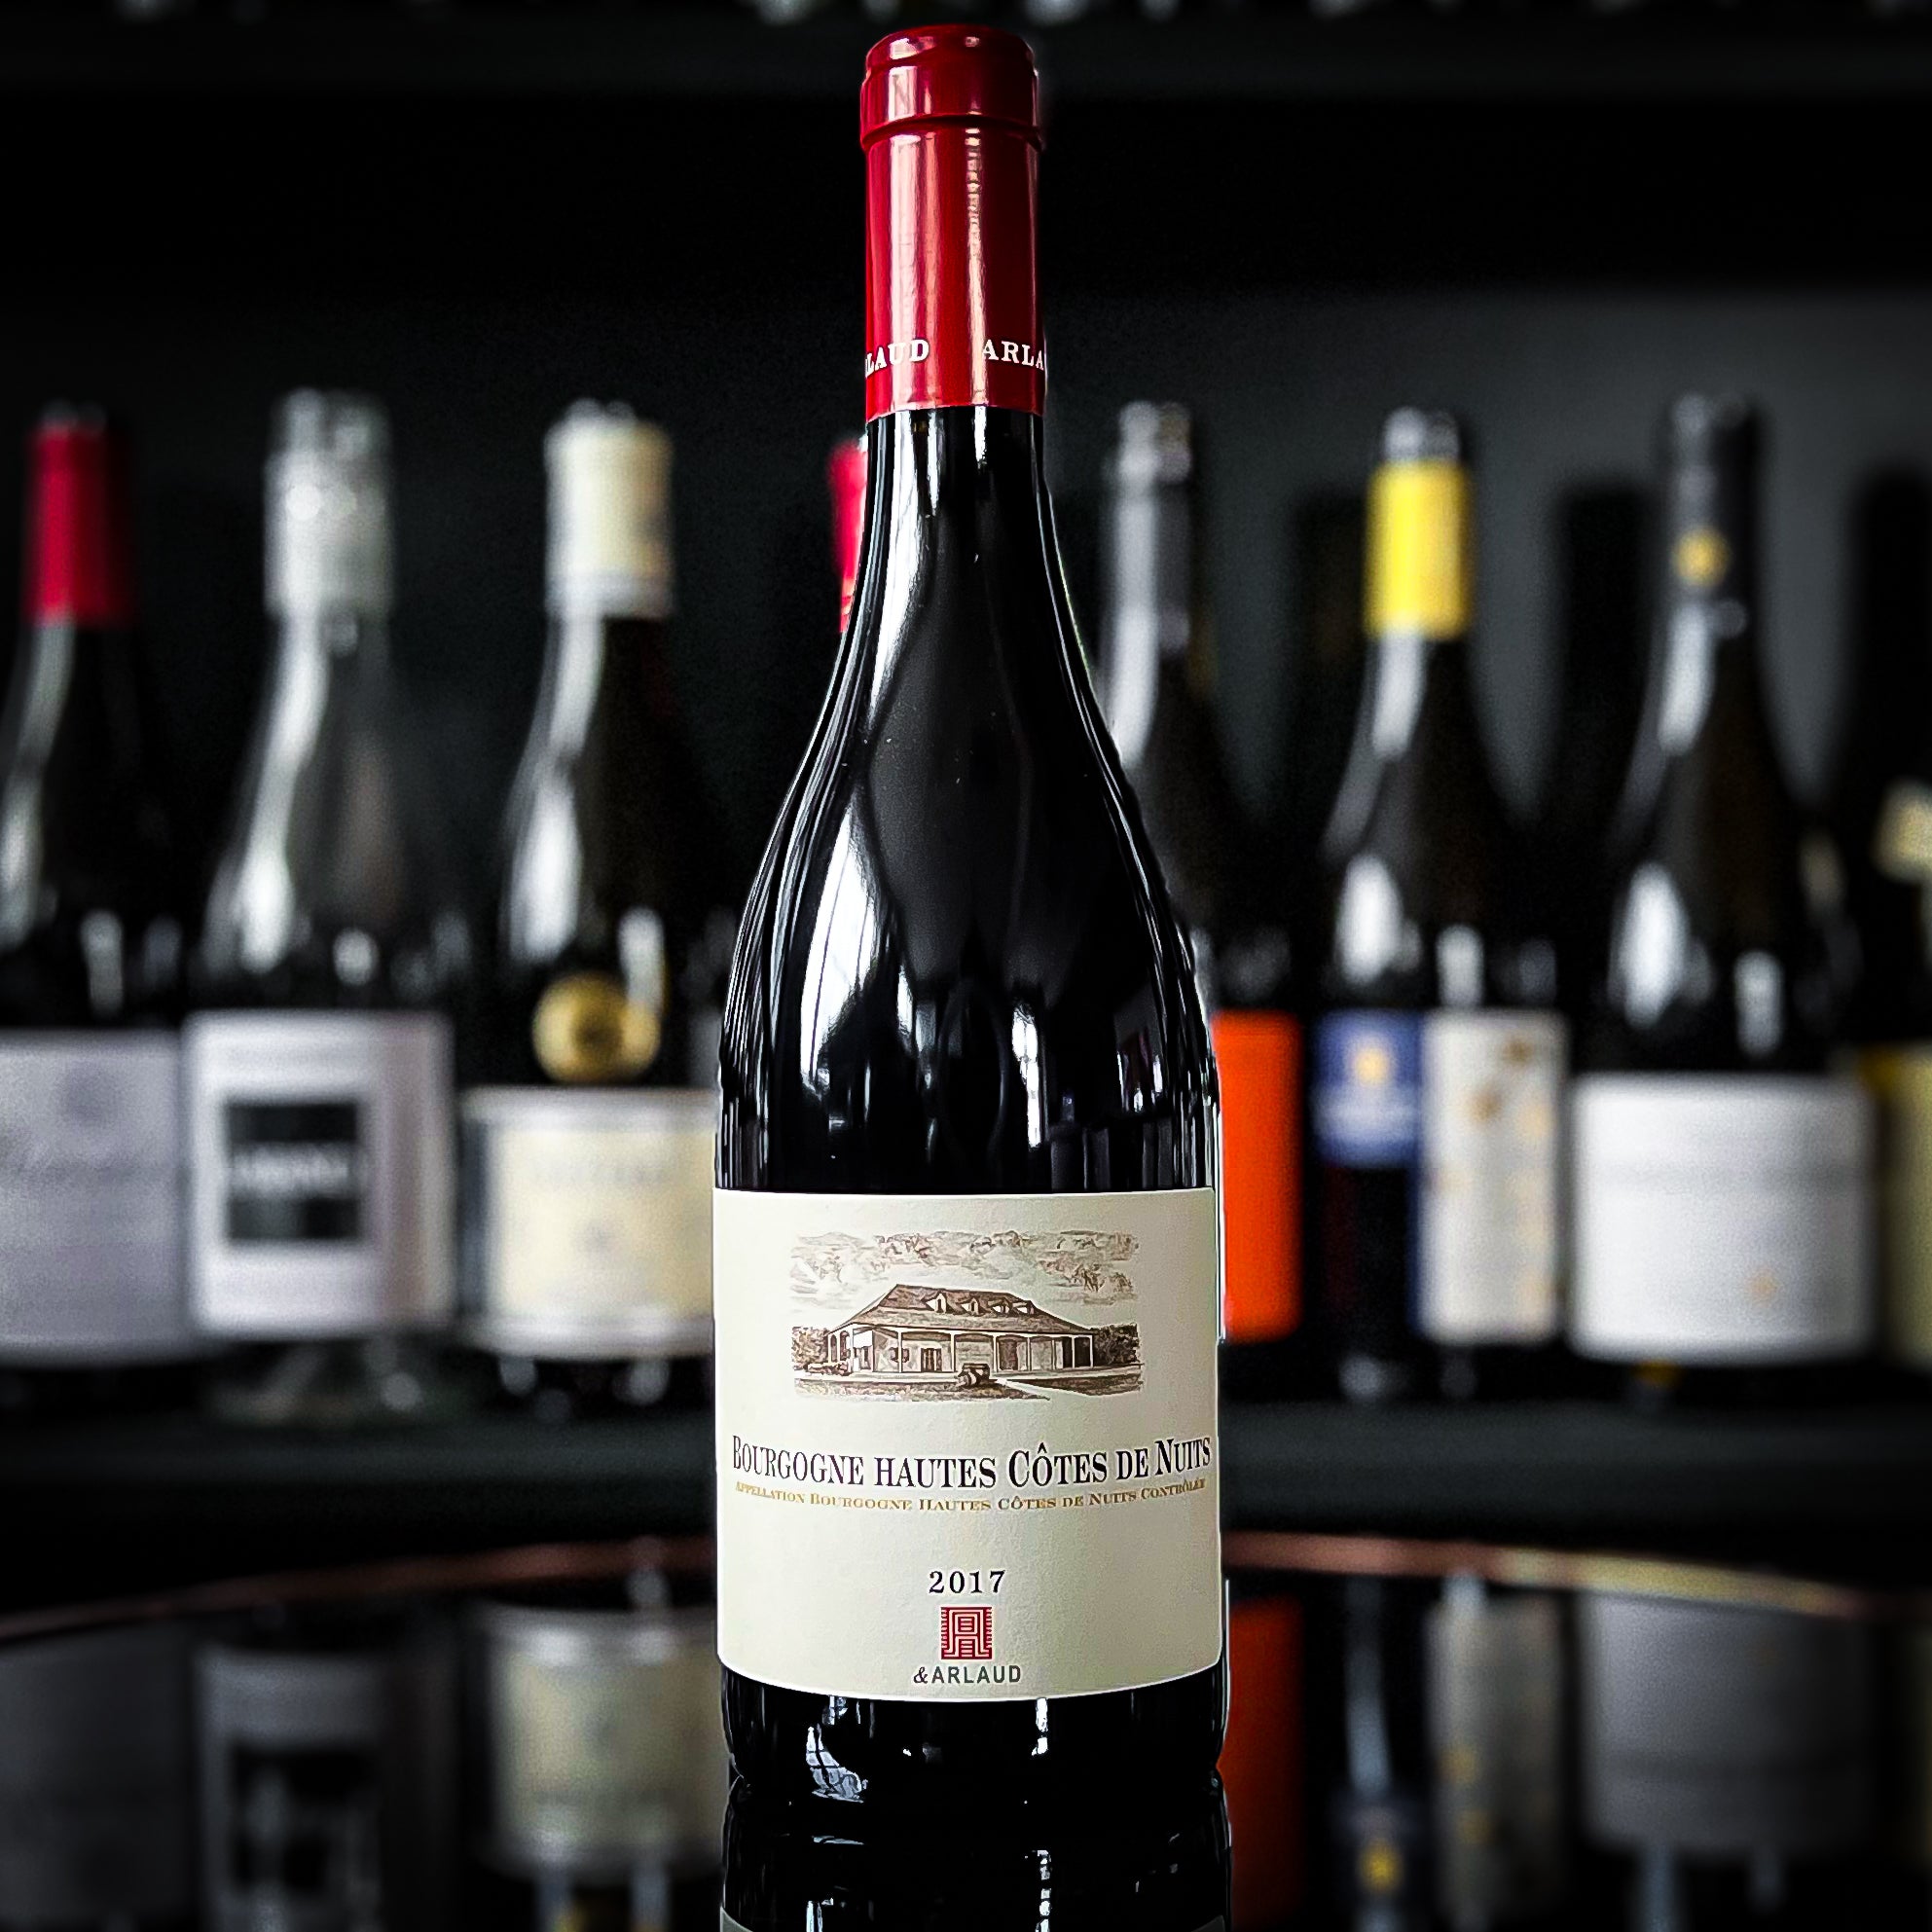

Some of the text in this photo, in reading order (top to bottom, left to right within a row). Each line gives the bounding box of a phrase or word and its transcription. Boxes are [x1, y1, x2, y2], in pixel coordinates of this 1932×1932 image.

[865, 339, 930, 378] LAUD
[733, 1435, 1211, 1488] BOURGOGNE HAUTES CÔTES DE NUITS
[736, 1481, 805, 1504] APPELLATION
[810, 1492, 913, 1511] BOURGOGNE
[919, 1498, 991, 1512] HAUTES
[998, 1495, 1057, 1511] CÔTES
[1063, 1496, 1083, 1508] DE
[1089, 1490, 1137, 1506] NUITS
[929, 1569, 1006, 1594] 2017
